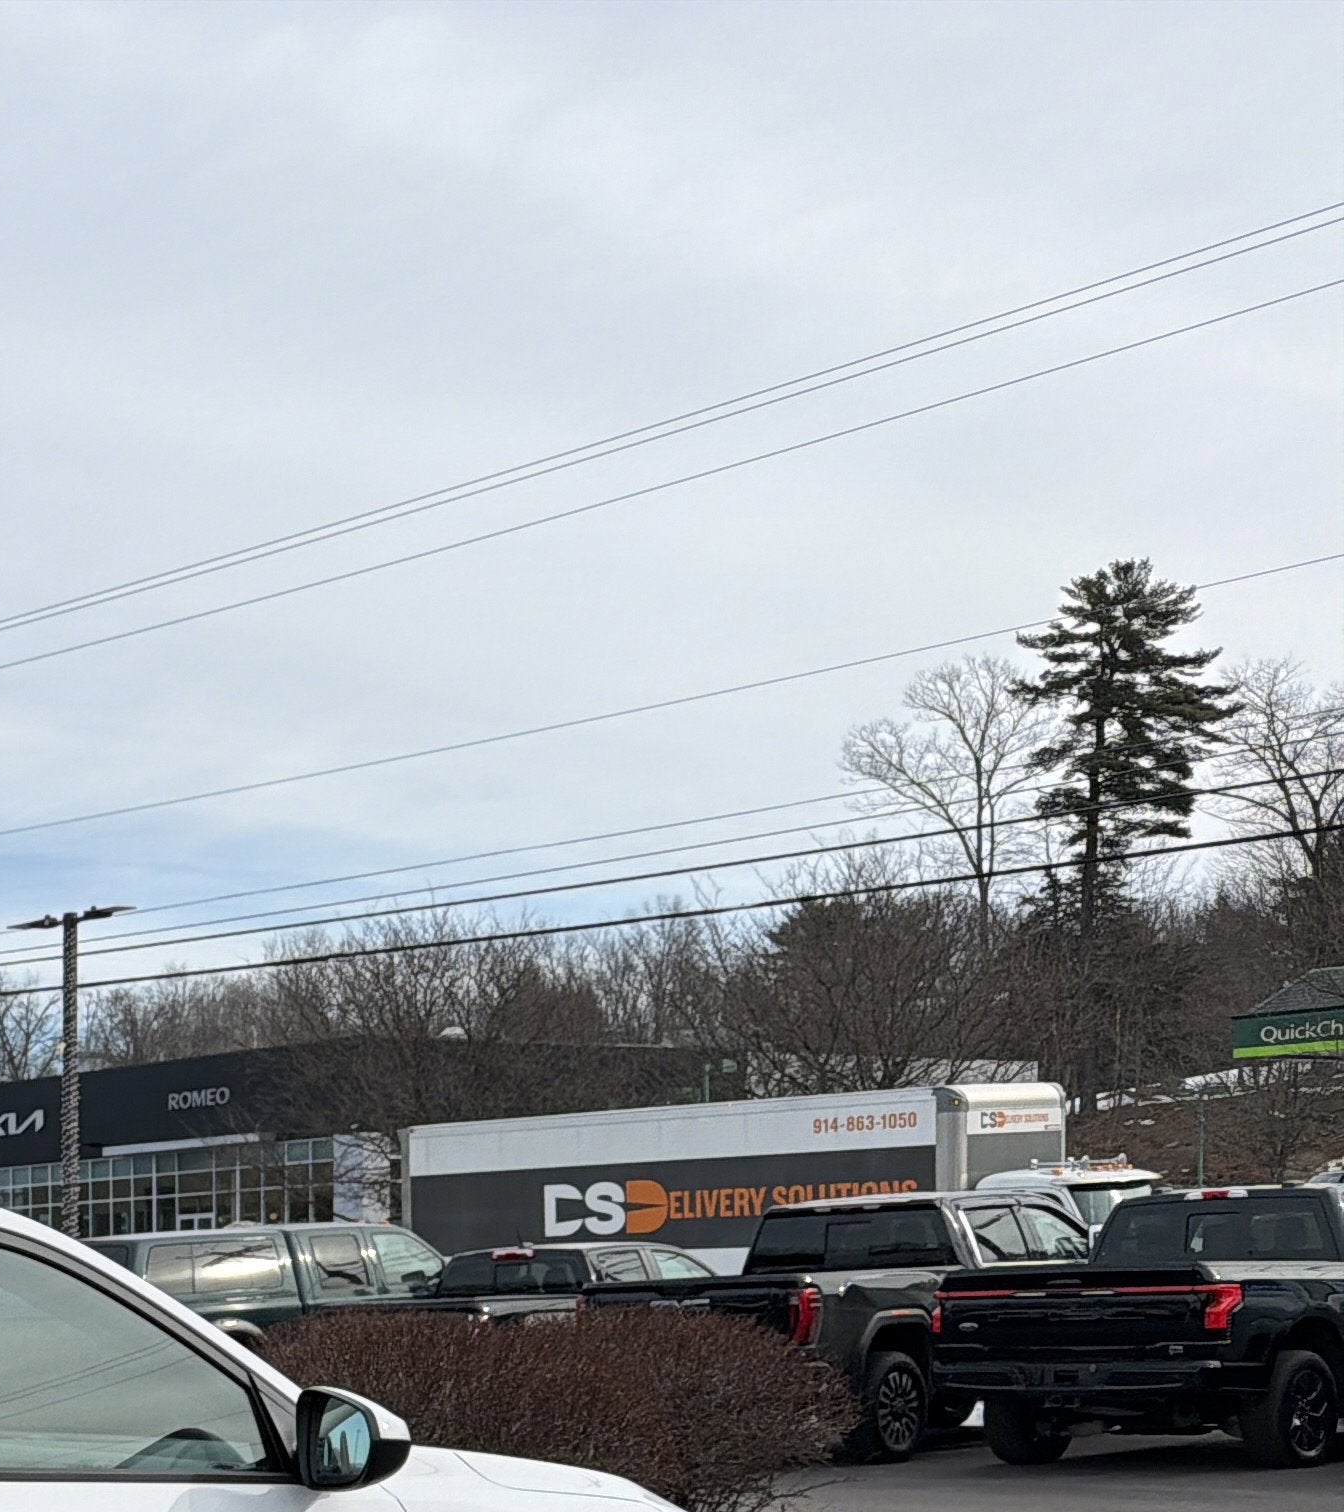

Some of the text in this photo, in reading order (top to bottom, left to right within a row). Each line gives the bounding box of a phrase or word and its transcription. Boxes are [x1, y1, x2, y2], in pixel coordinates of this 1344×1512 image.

[1260, 1019, 1344, 1044] QuickCh
[168, 1087, 230, 1111] ROMEO
[813, 1111, 917, 1134] 914-863-1050
